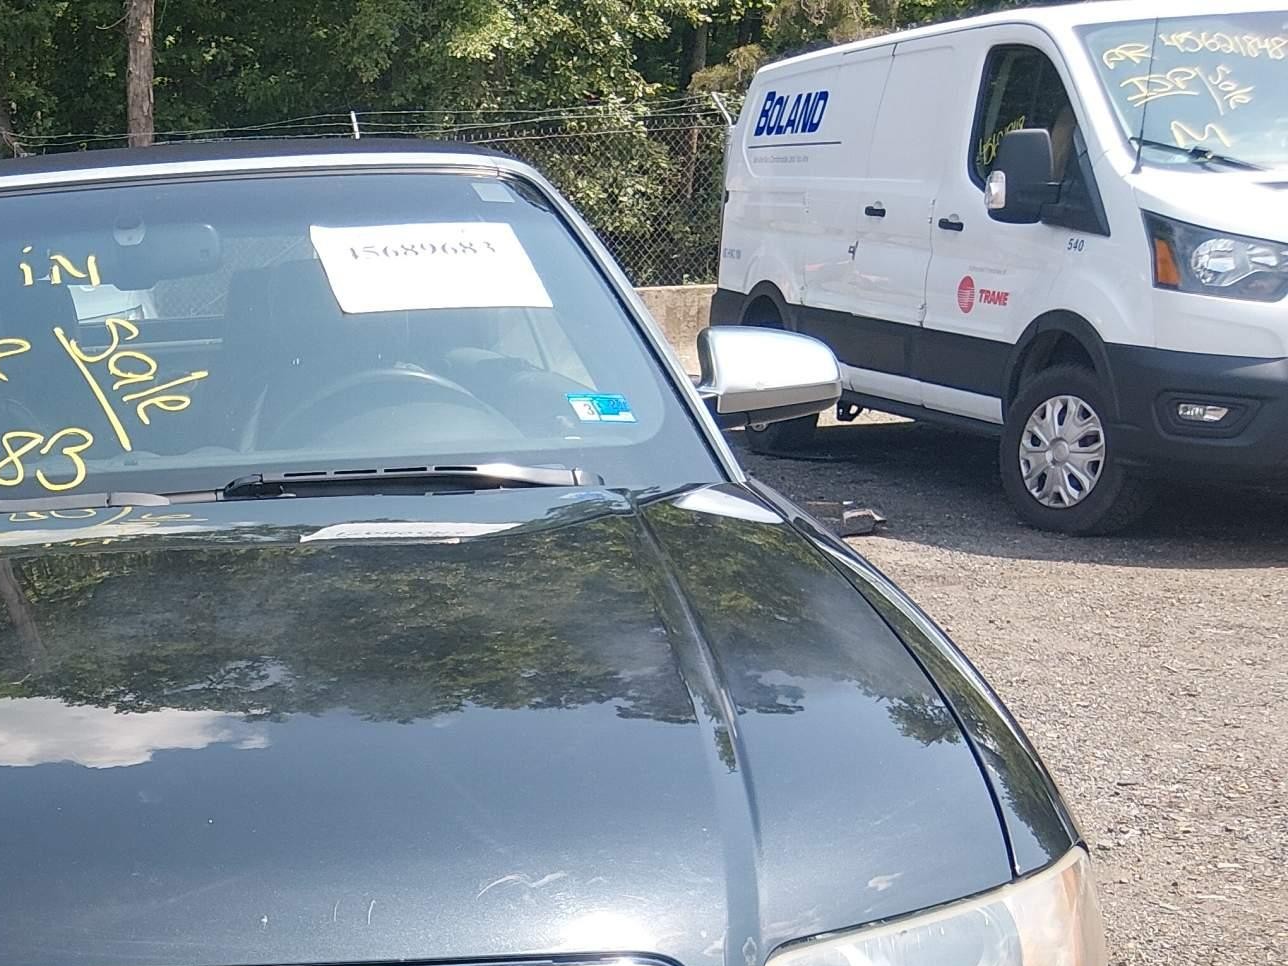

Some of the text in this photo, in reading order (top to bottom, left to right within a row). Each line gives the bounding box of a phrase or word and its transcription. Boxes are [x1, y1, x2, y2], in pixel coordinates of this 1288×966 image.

[753, 90, 830, 137] BOLAND
[1067, 238, 1085, 252] 540
[978, 288, 1010, 306] TRANE
